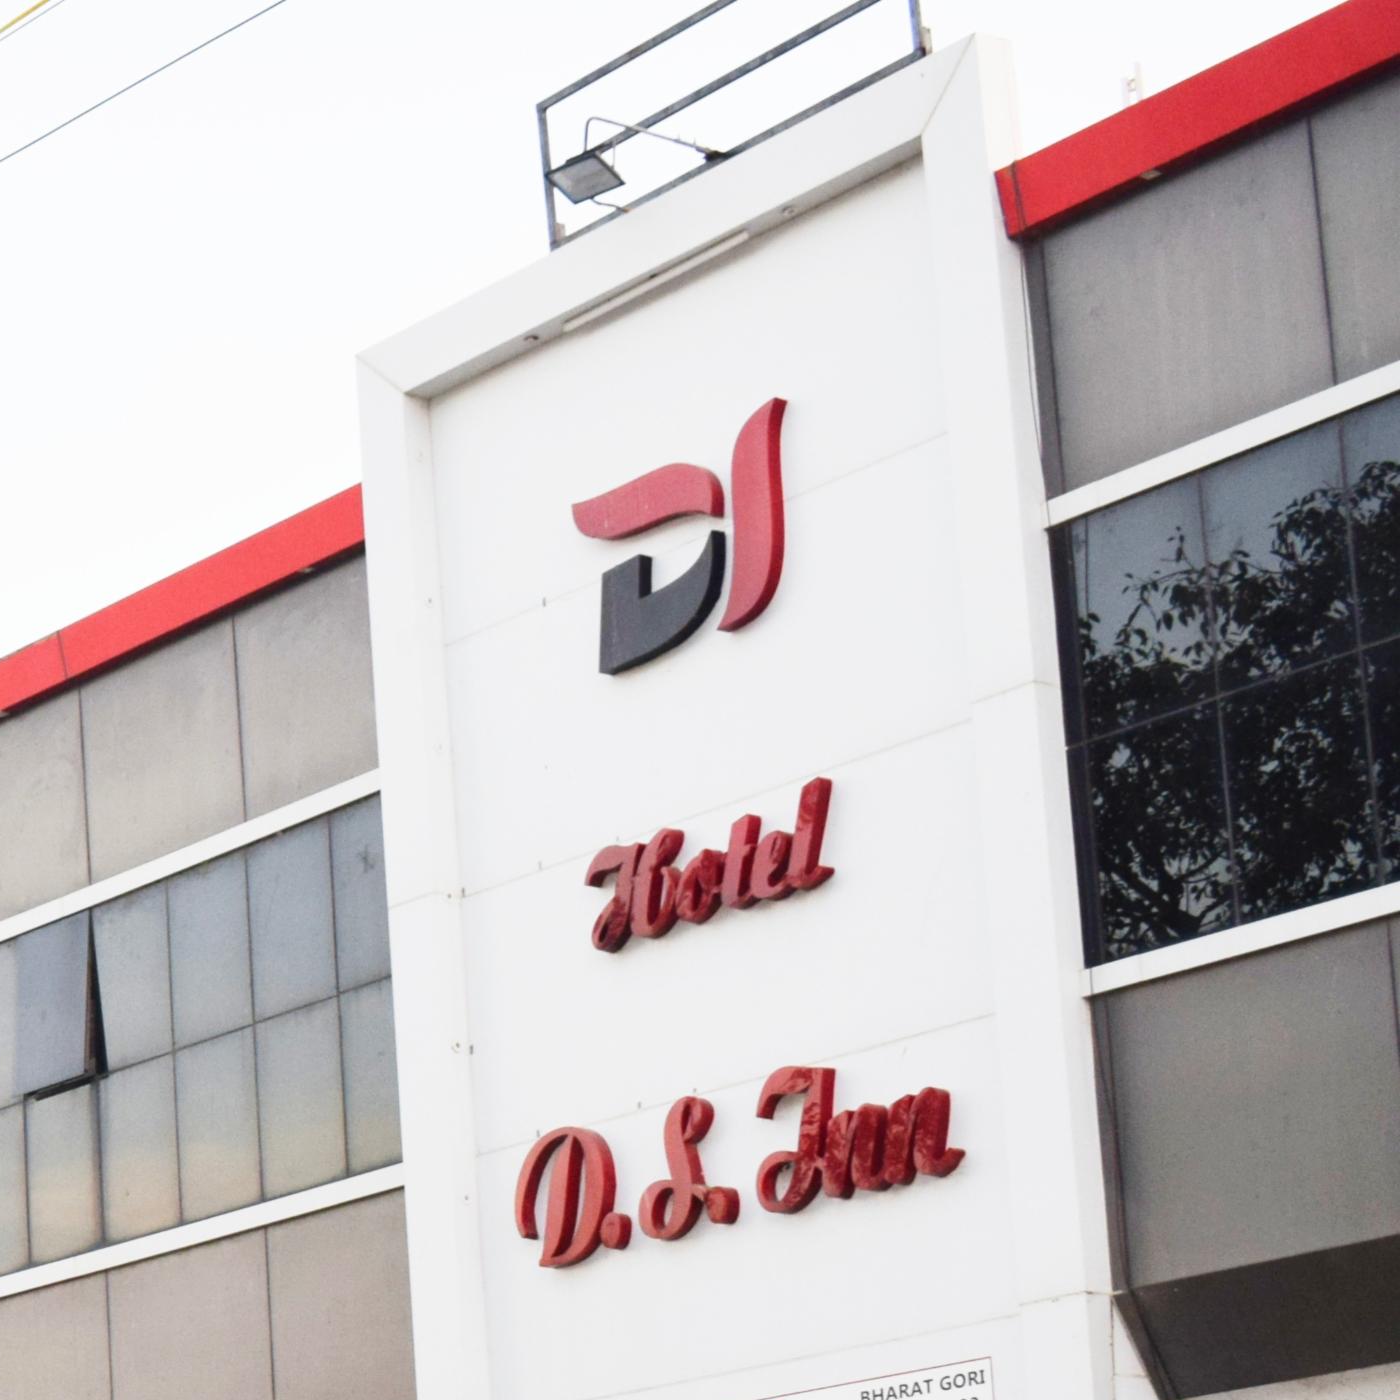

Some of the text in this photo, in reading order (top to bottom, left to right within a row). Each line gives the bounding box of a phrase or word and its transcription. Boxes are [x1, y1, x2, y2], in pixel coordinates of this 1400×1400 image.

[585, 776, 836, 954] Hotel
[515, 1065, 966, 1269] D.S. Inn
[940, 1369, 985, 1391] GORI
